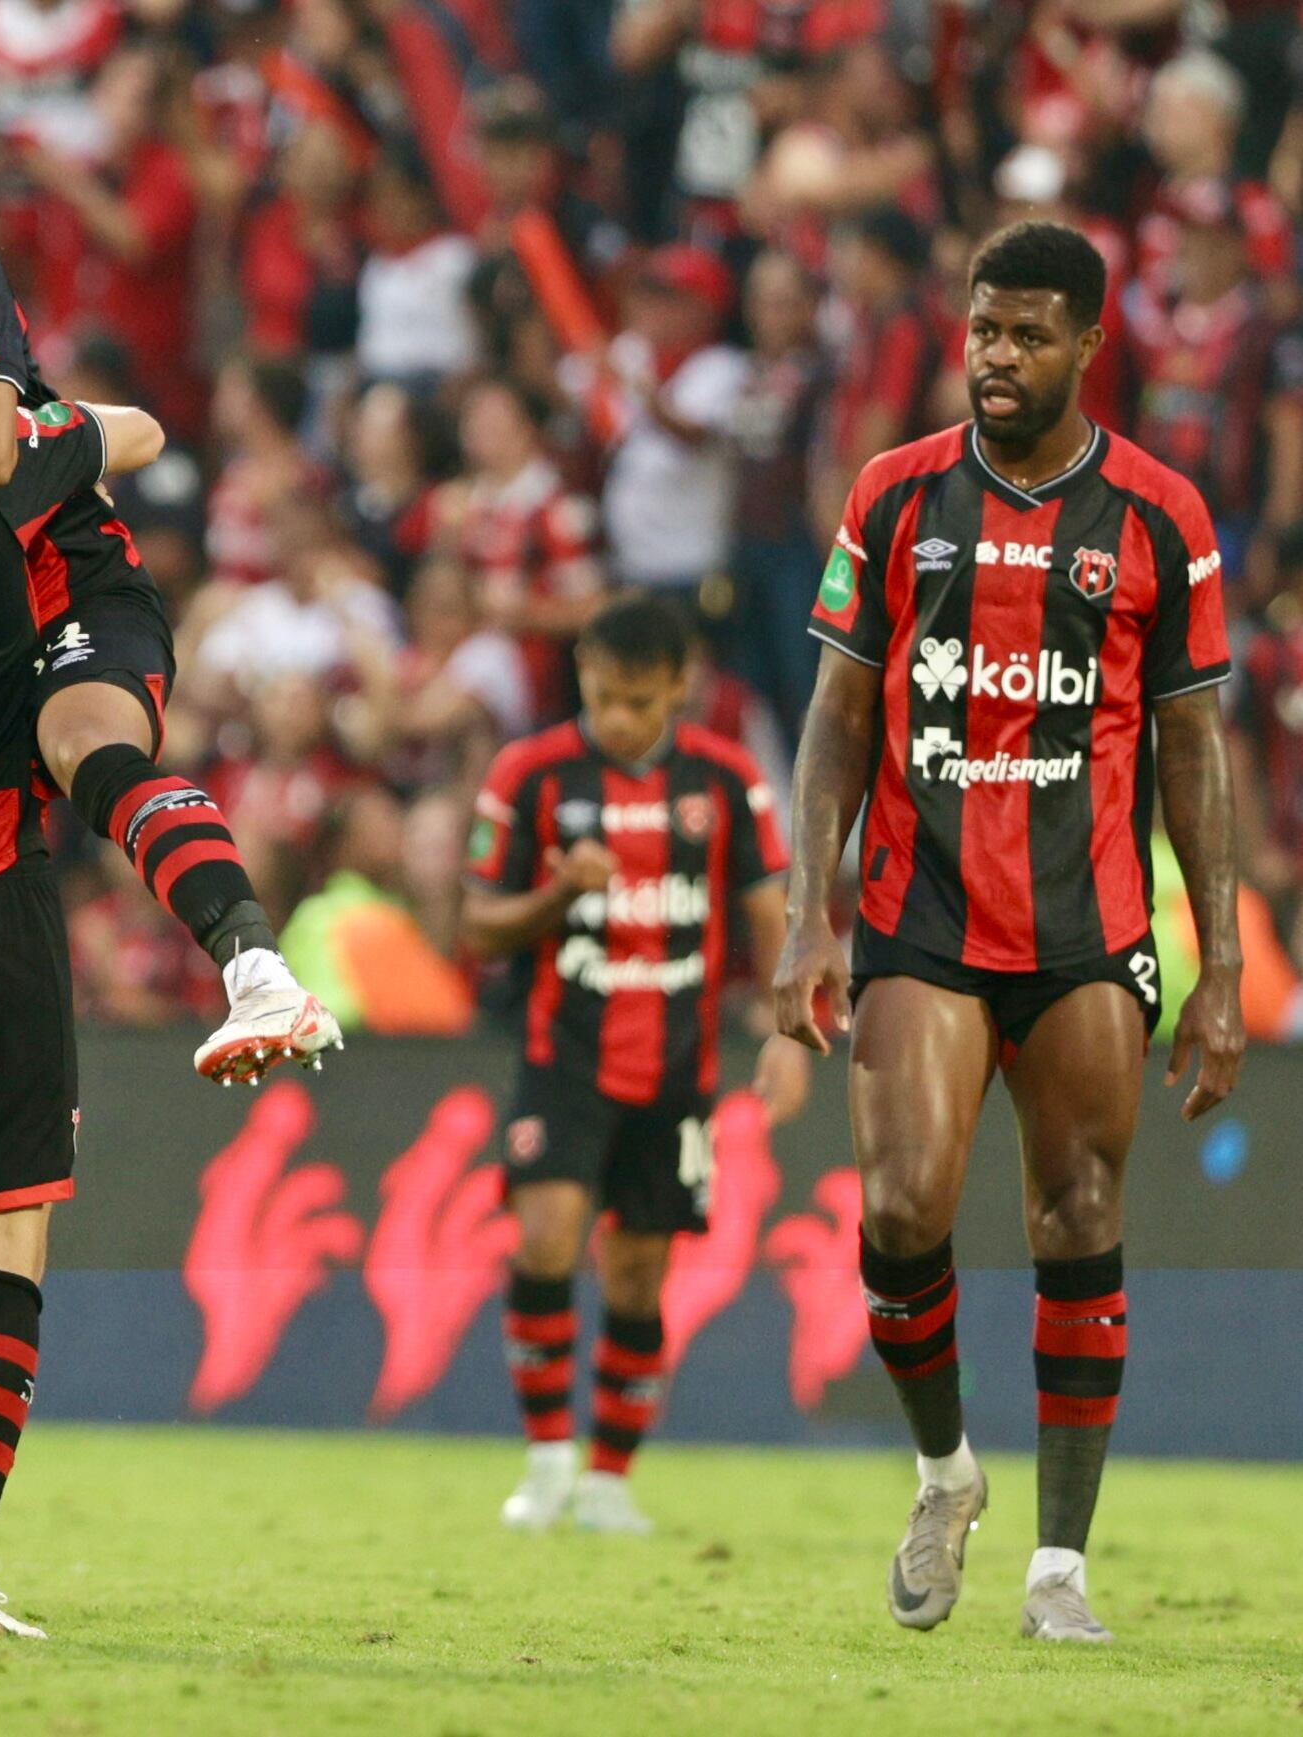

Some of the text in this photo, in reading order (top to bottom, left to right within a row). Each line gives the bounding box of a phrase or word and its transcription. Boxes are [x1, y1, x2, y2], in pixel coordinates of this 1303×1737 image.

[1003, 541, 1053, 569] BAC
[971, 643, 1099, 706] kölbi
[938, 750, 1083, 790] medismart
